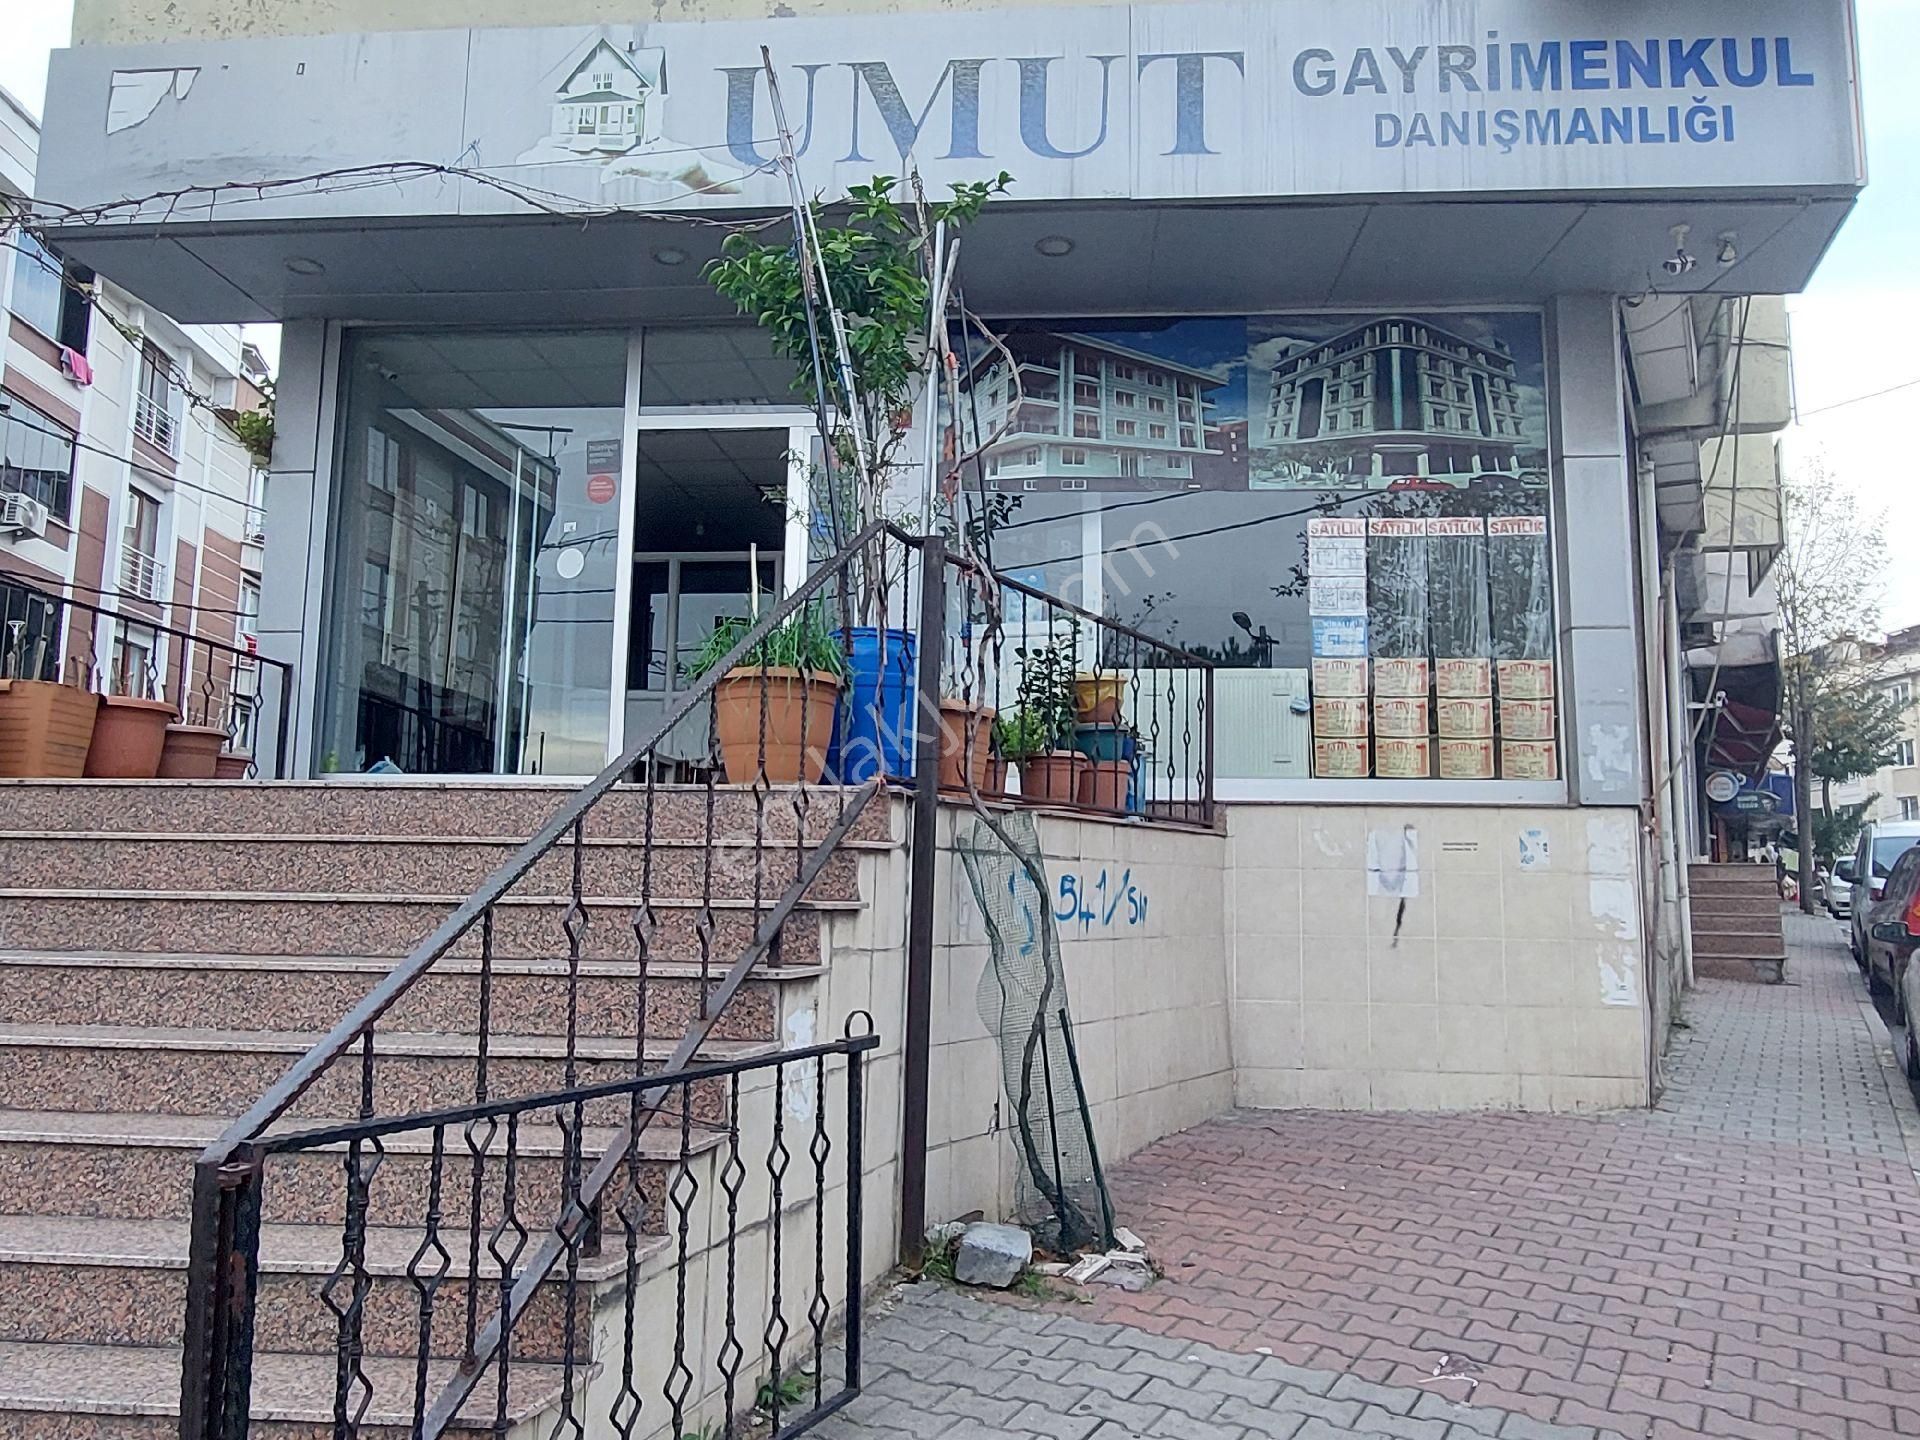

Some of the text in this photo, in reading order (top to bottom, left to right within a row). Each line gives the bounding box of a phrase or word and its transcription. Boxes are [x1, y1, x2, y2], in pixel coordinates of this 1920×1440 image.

[1291, 30, 1815, 97] GAYRİMENKUL
[713, 51, 1246, 169] UMUT
[1373, 95, 1736, 155] DANIŞMANLIĞI
[1310, 521, 1364, 535] SATILIK
[1370, 520, 1424, 535] SATILIK
[1428, 519, 1483, 535] SATILIK
[1489, 519, 1544, 534] SATILIK
